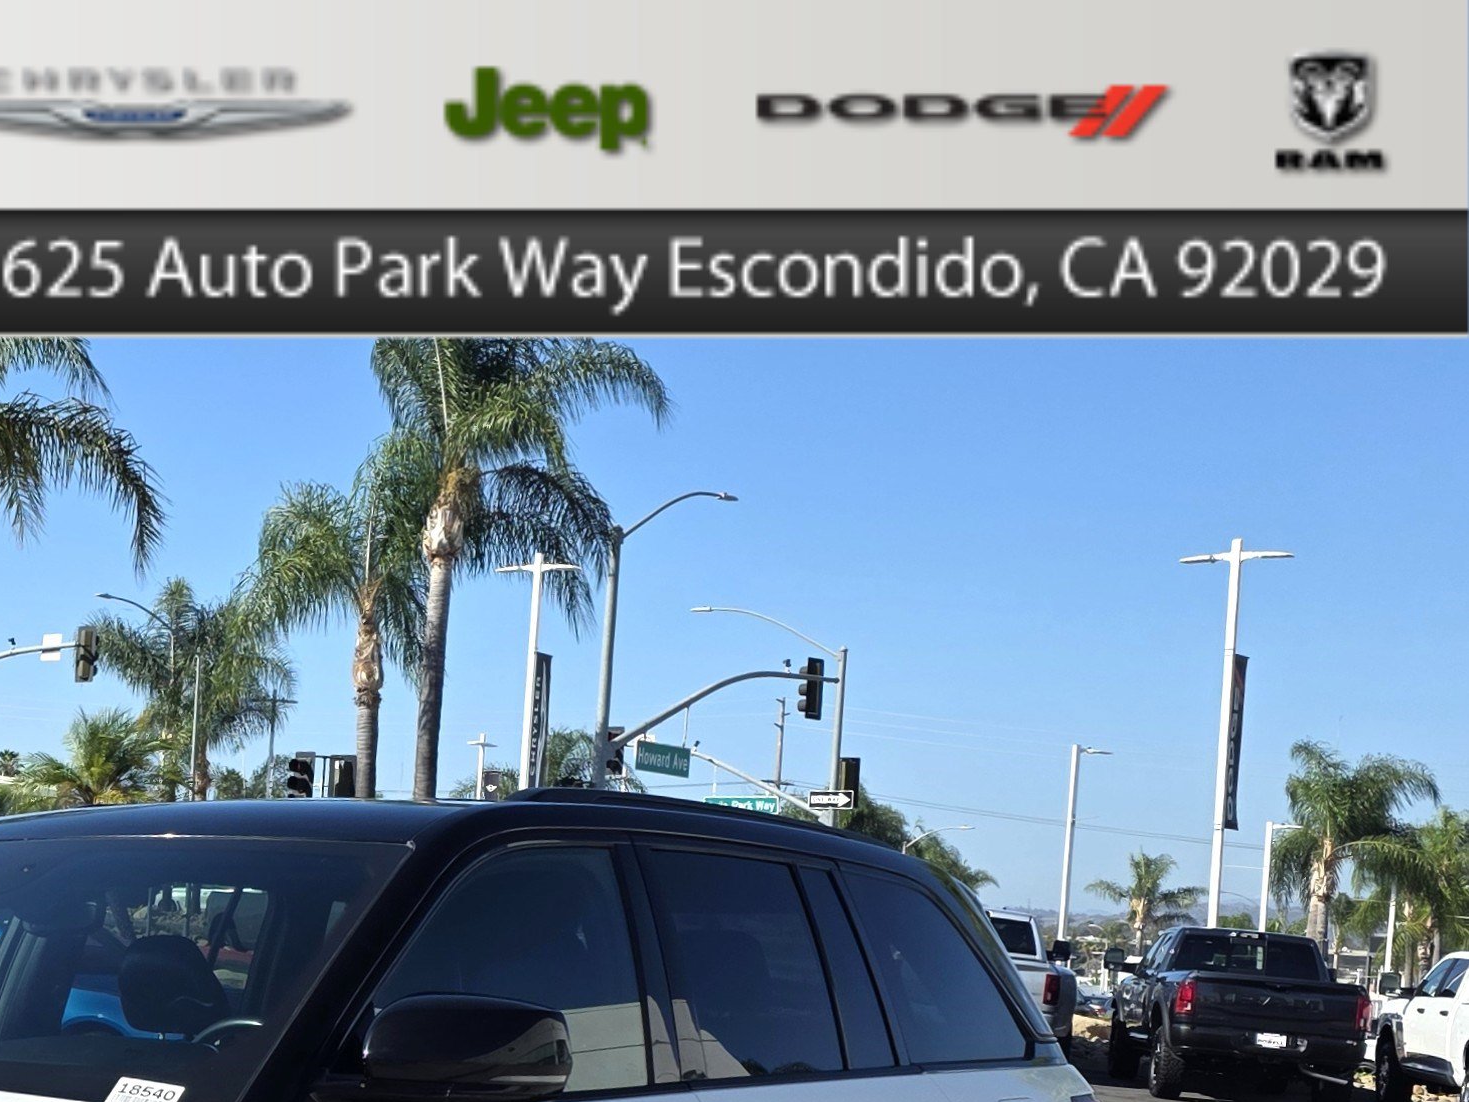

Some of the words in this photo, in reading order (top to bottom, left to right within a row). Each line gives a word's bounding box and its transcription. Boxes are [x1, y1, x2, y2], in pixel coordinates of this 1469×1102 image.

[530, 675, 542, 776] CHRYSLER
[637, 746, 671, 768] Howard
[673, 753, 689, 771] Ave
[755, 800, 776, 812] Way
[117, 1082, 177, 1101] 18540
